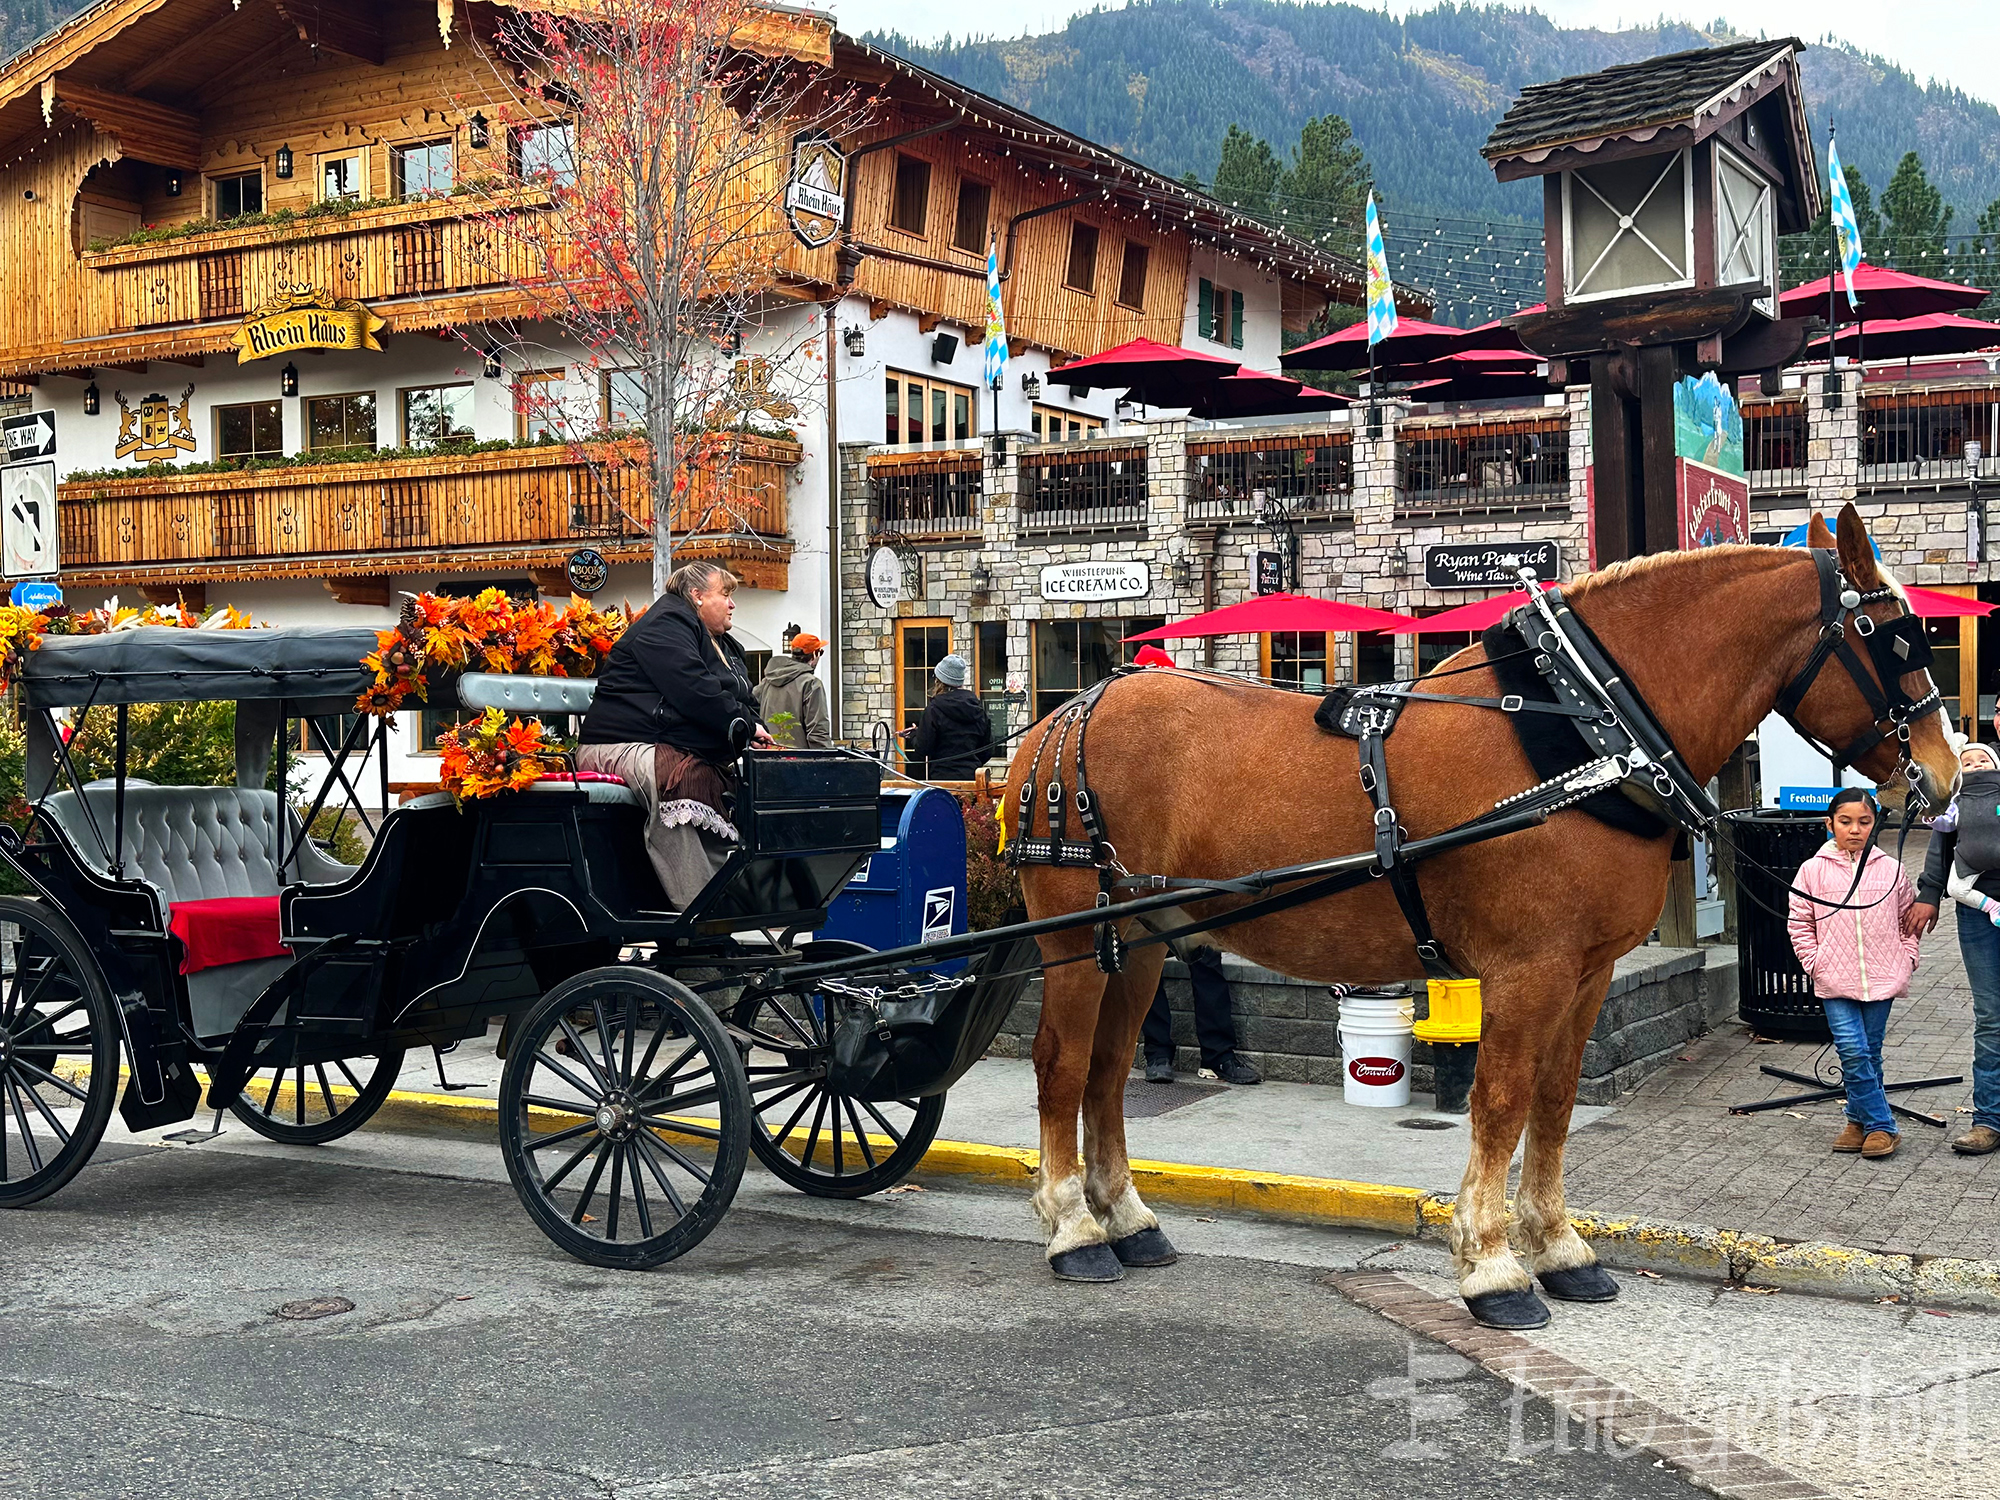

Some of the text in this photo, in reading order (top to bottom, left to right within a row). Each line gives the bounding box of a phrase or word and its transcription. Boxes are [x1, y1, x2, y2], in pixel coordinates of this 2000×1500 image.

[799, 187, 820, 210] Rhein
[247, 321, 306, 354] Rhein
[20, 427, 37, 446] WAY
[1689, 477, 1731, 541] Waterfront
[1434, 545, 1548, 573] Ryan Parick
[1062, 567, 1126, 578] WHISTLEPUNK
[1455, 569, 1483, 582] Wine
[1046, 577, 1143, 593] ICE CREAM CO.
